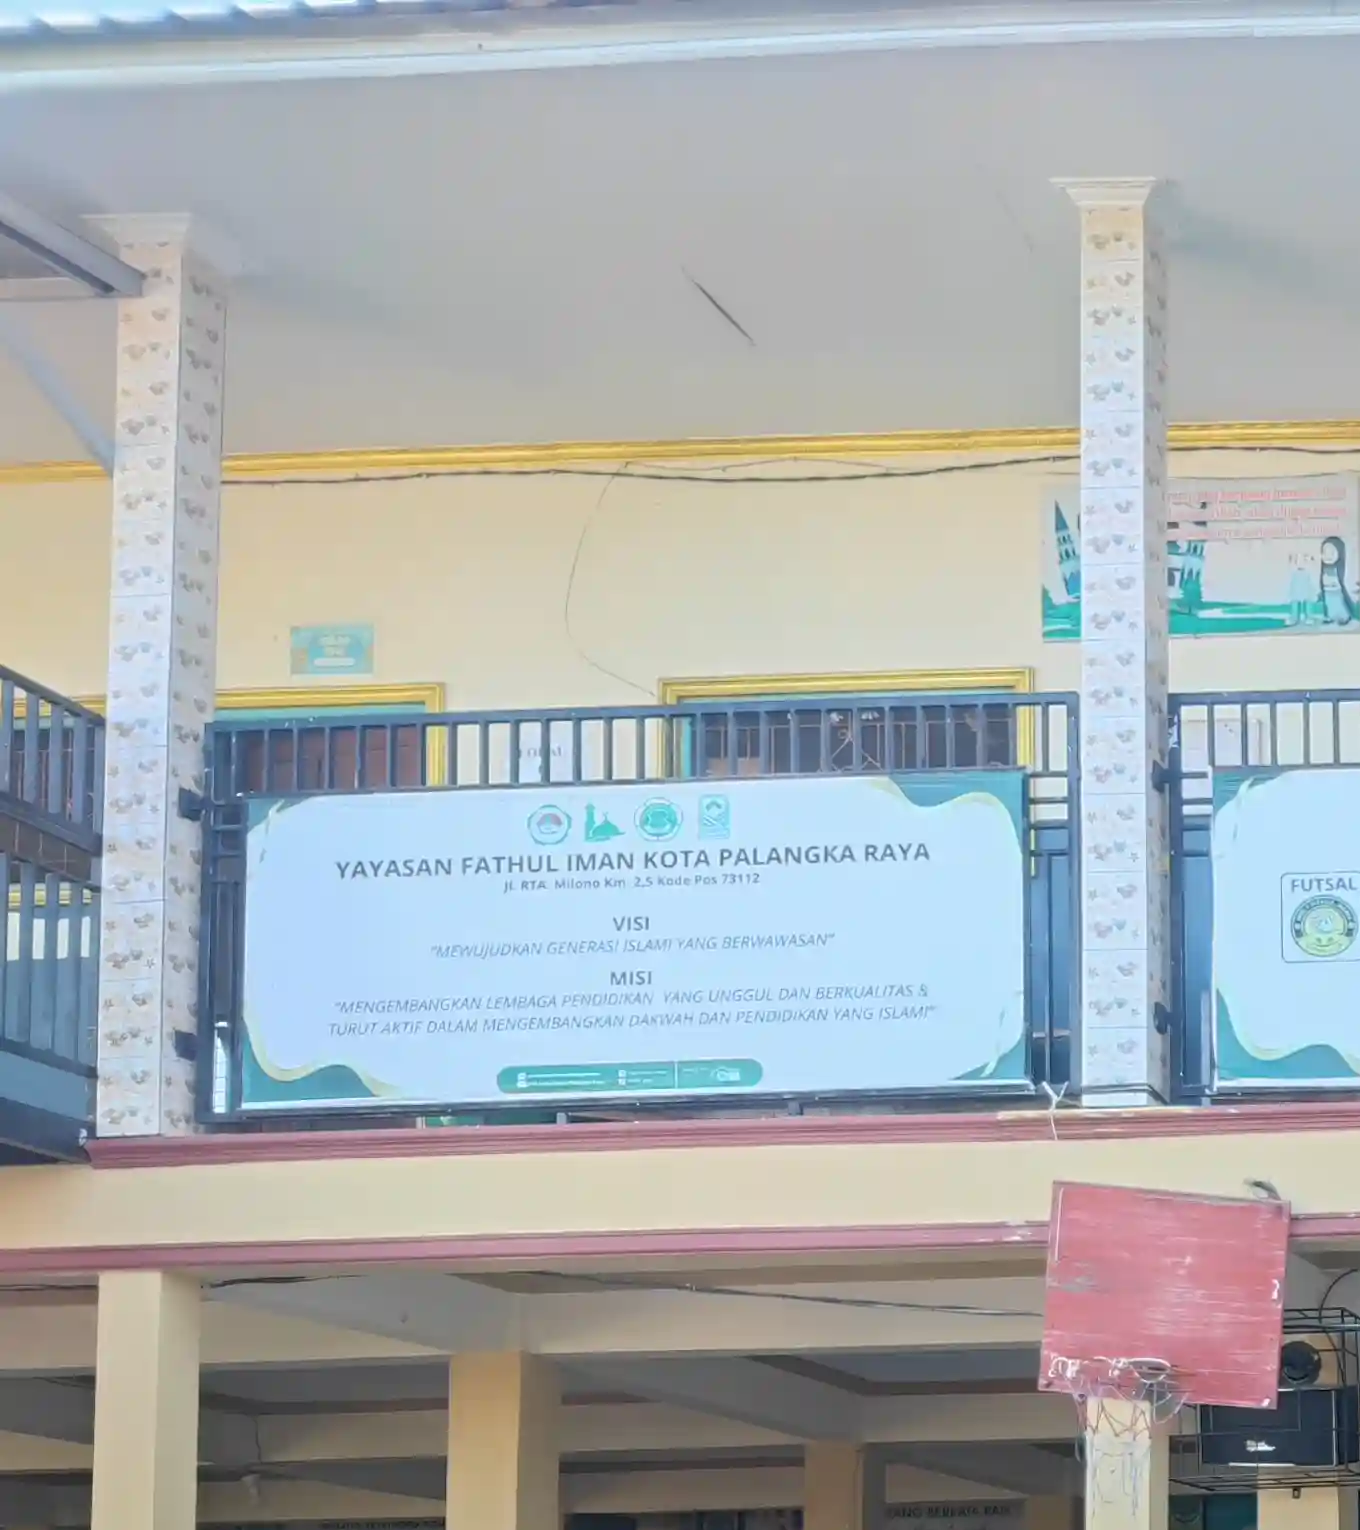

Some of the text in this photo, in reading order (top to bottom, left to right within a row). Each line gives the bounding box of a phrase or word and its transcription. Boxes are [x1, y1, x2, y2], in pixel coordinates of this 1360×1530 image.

[335, 842, 931, 880] YAYASAN FATHUL IMAN KOTA PALANGKA RAYA
[554, 877, 600, 889] Milono
[657, 874, 691, 887] Kode
[694, 873, 718, 886] Pos
[722, 872, 761, 885] 73112
[1291, 878, 1358, 893] FUTSAL
[613, 916, 650, 932] VISI
[547, 939, 619, 955] GENERASI
[622, 937, 673, 953] ISLAMI
[676, 936, 718, 951] YANG
[610, 970, 652, 986] MISI
[486, 994, 556, 1010] LEMBAGA
[561, 990, 654, 1007] PENDIDIKAN
[663, 988, 703, 1004] YANG
[708, 986, 772, 1002] UNGGUL
[779, 985, 811, 1001] DAN
[815, 983, 914, 1000] BERKUALITAS
[328, 1021, 378, 1037] TURUT
[379, 1019, 422, 1034] AKTIF
[426, 1018, 478, 1034] DALAM
[482, 1014, 625, 1031] MENGEMBANGKAN
[629, 1012, 693, 1027] DAKWAH
[698, 1010, 731, 1026] DAN
[735, 1008, 829, 1024] PENDIDIKAN
[833, 1006, 874, 1021] YANG
